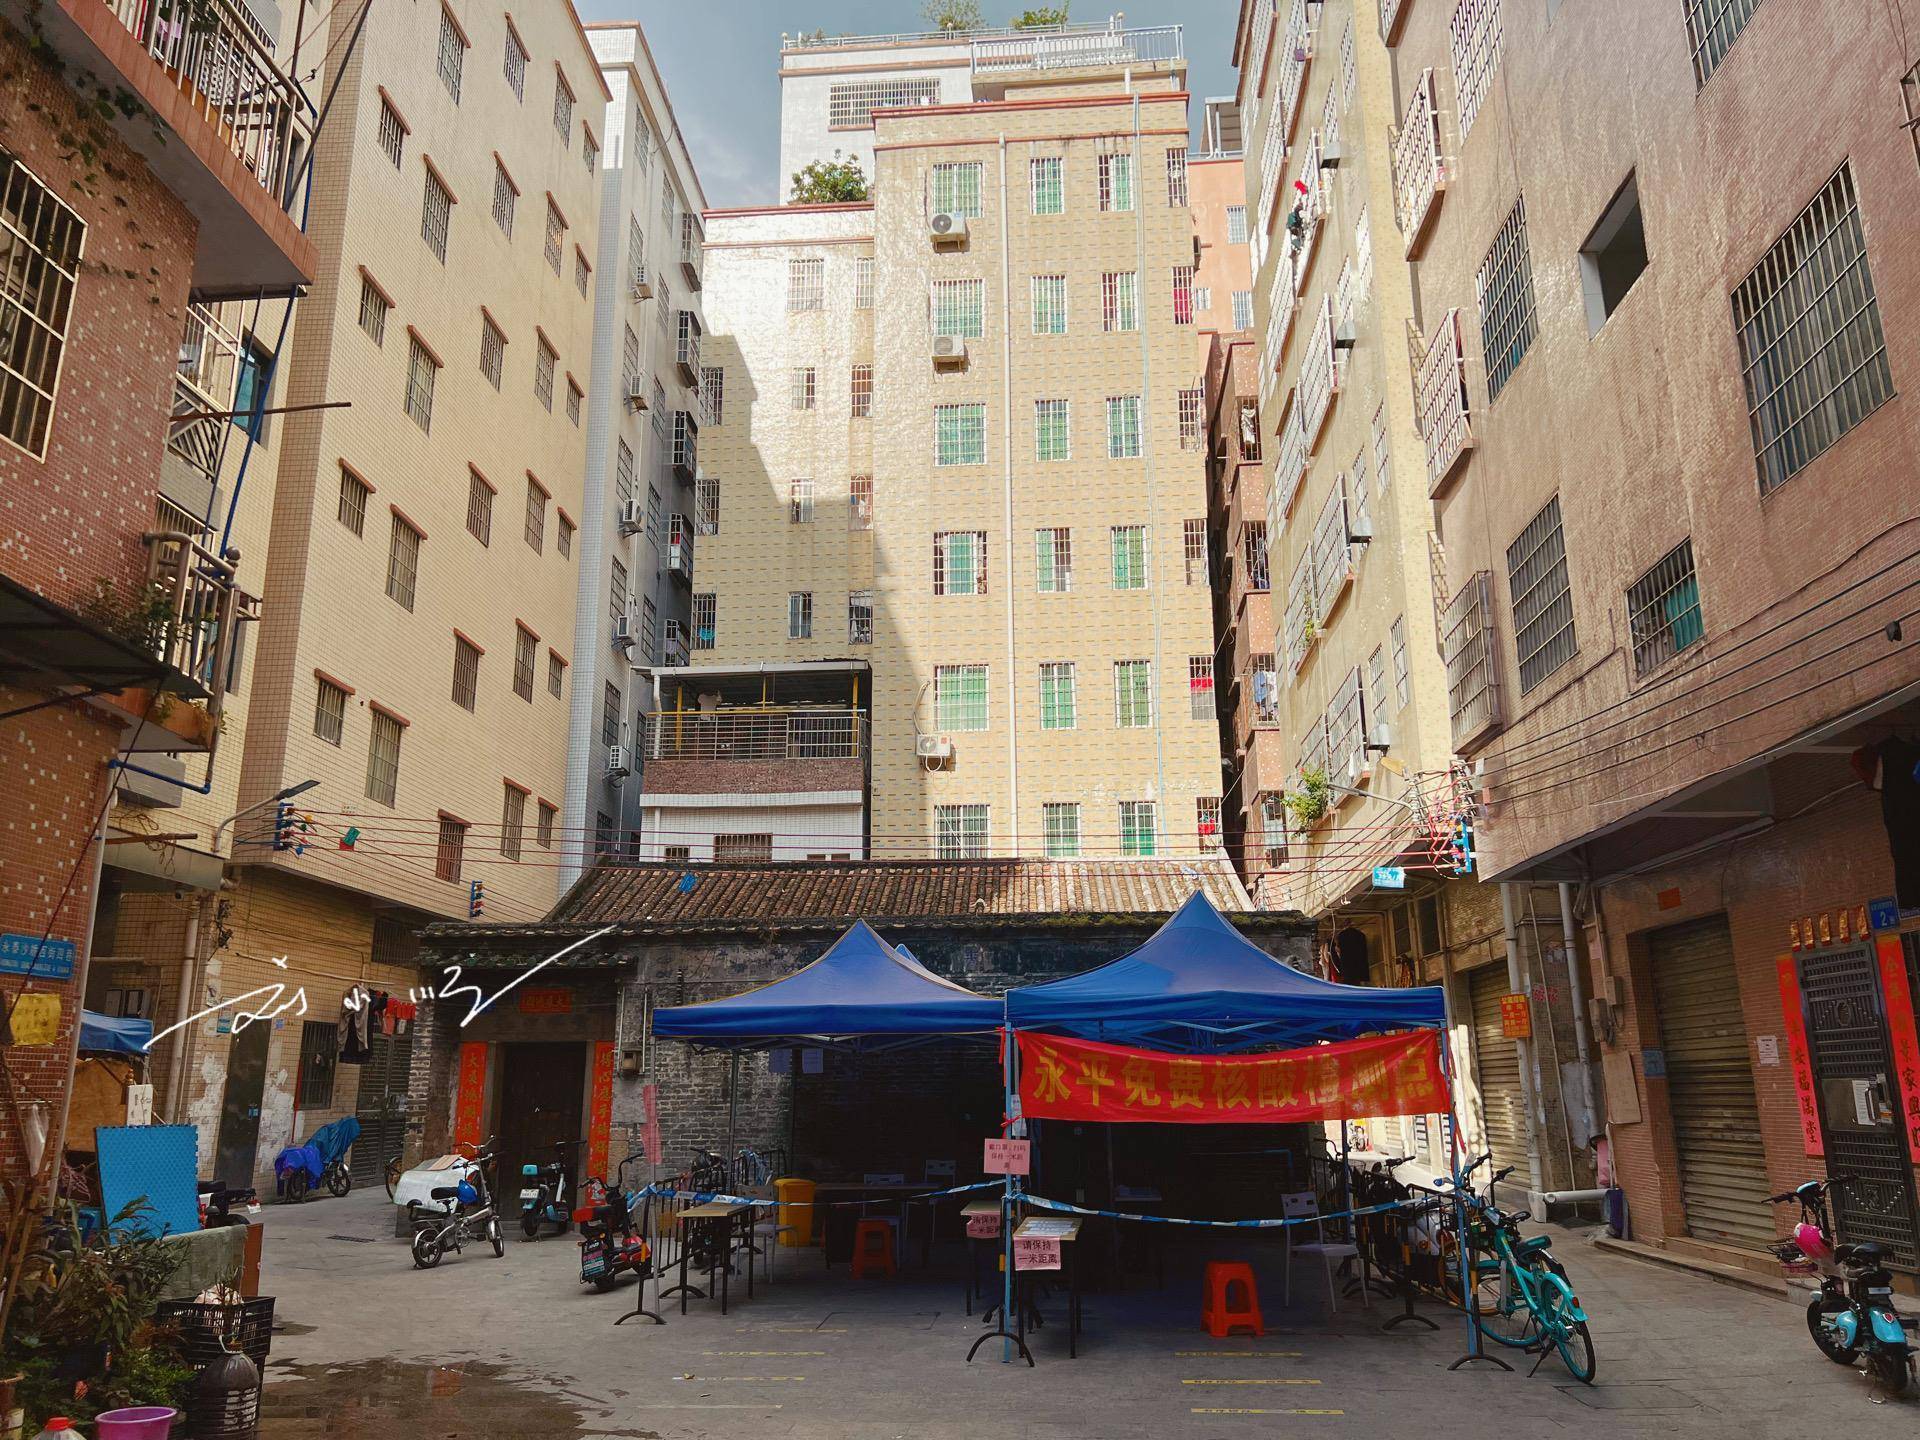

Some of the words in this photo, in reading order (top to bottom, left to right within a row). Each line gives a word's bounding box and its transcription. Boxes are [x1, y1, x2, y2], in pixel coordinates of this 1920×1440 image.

[1033, 1044, 1434, 1110] 永平免费核酸检测点
[1022, 1240, 1051, 1251] 请保持
[1018, 1252, 1058, 1265] 一米距离
